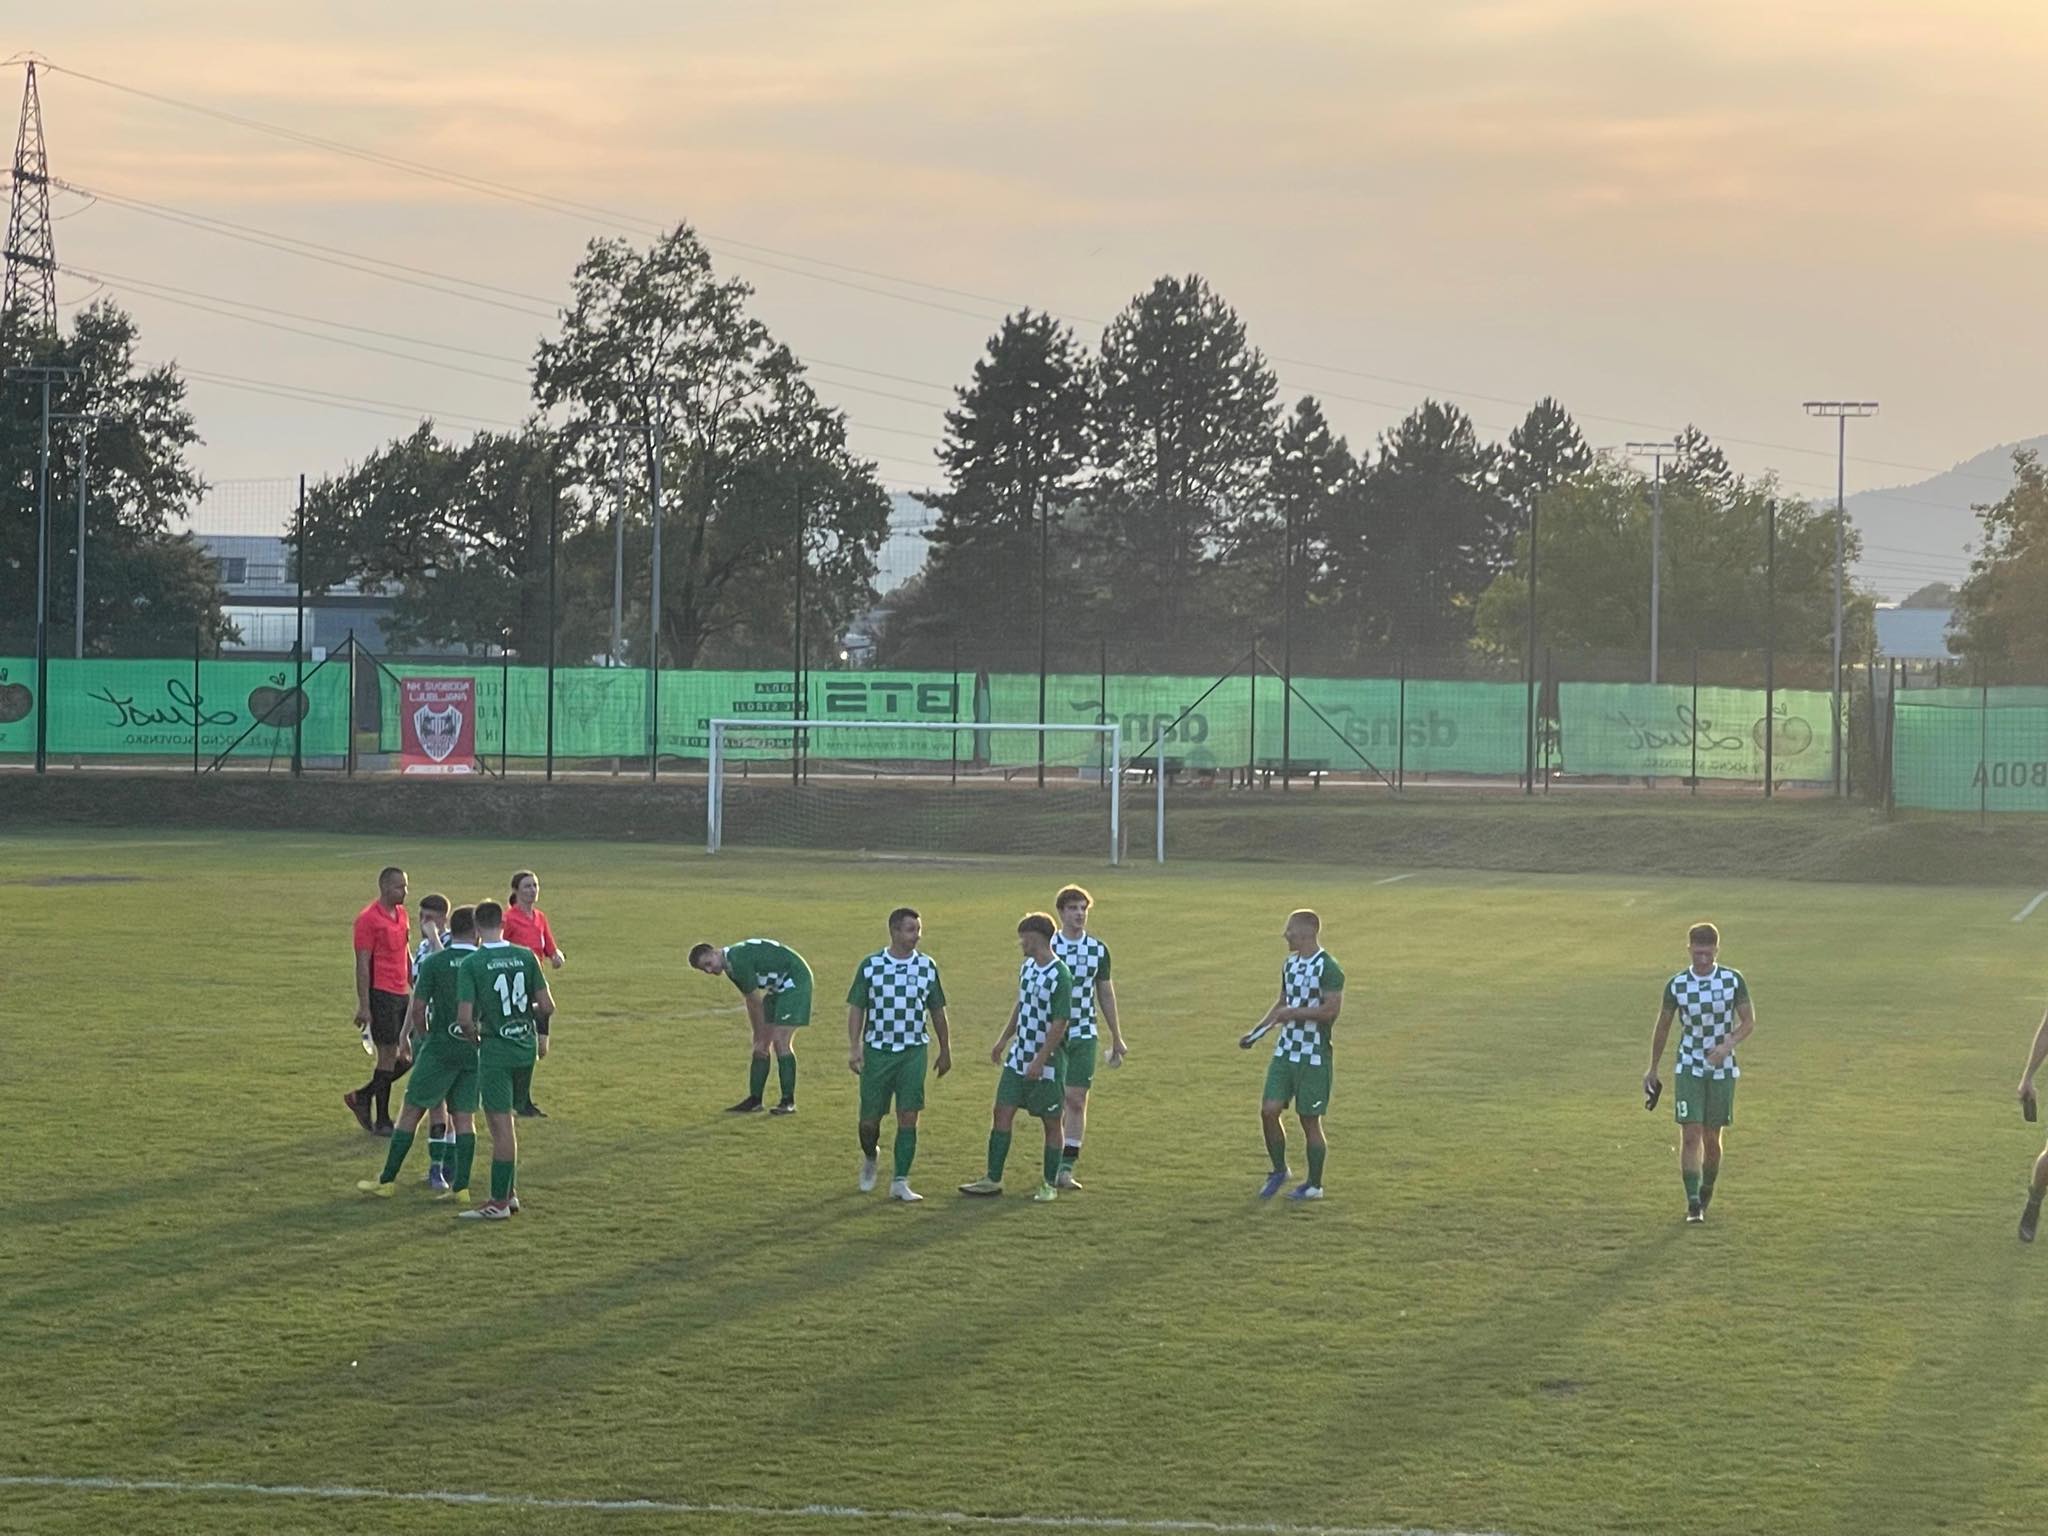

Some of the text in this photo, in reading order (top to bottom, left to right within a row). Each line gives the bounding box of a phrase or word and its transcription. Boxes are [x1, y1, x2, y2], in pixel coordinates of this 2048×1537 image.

[424, 682, 470, 692] SVOBODA
[409, 692, 468, 702] LJUBLJANA
[493, 971, 529, 1017] 14
[1676, 1100, 1689, 1119] 13
